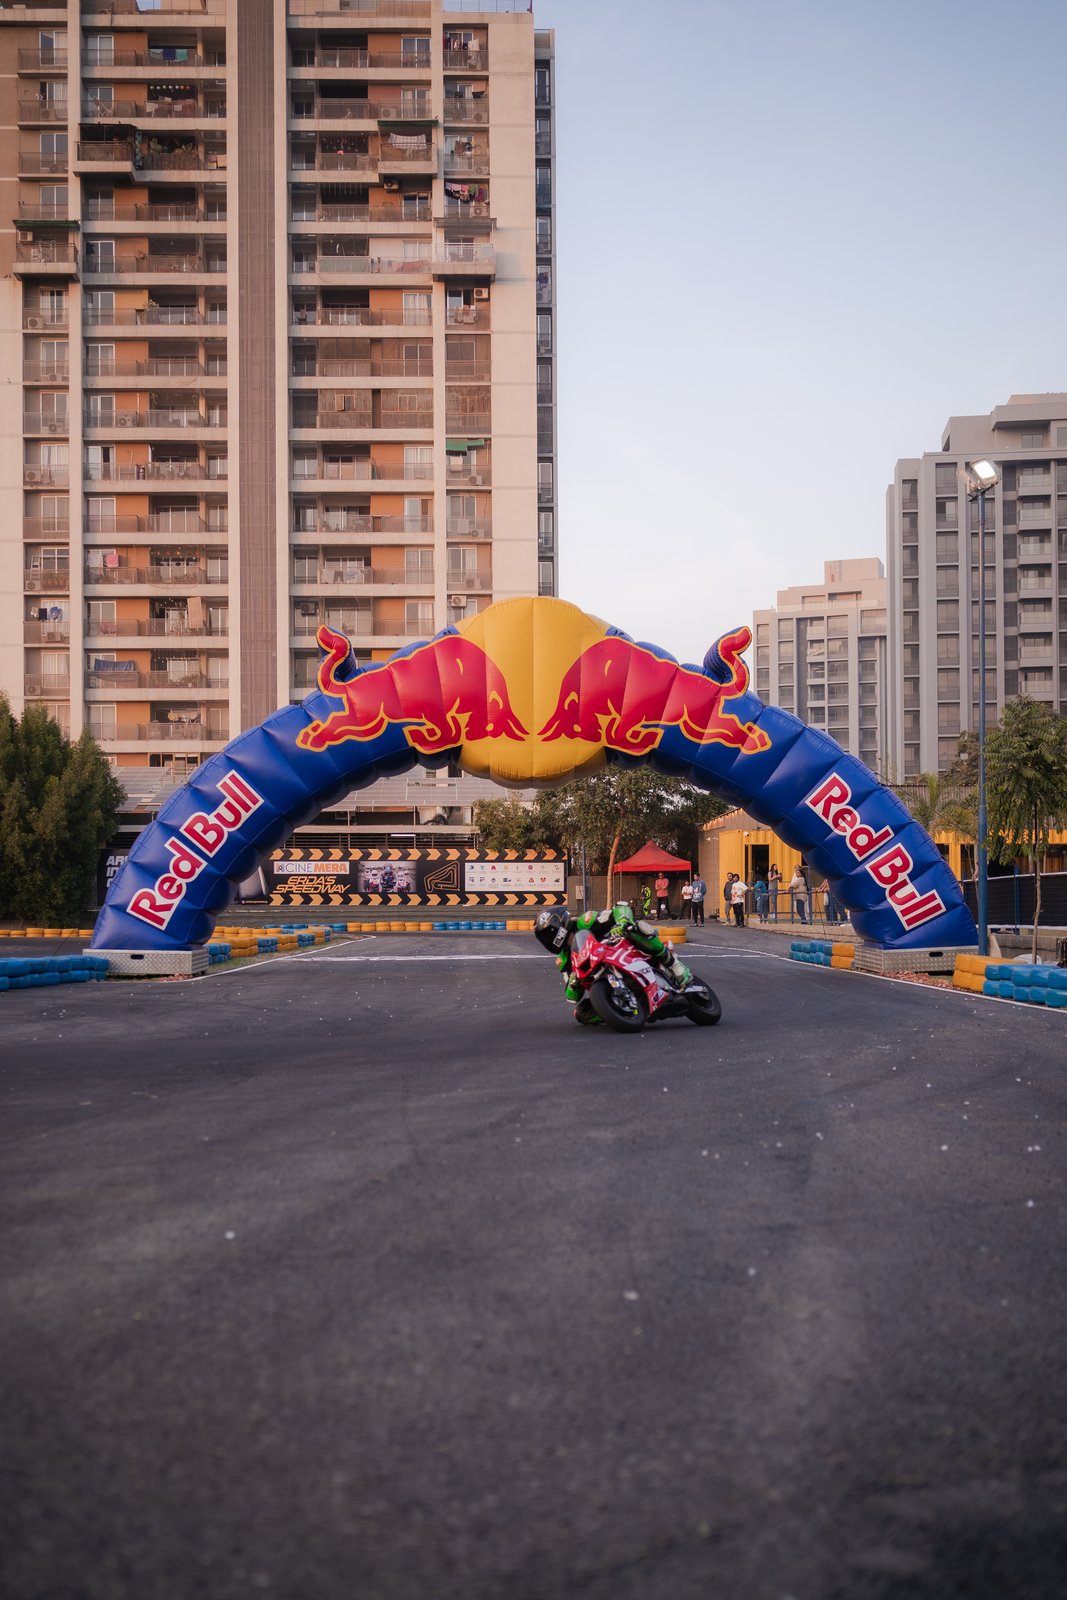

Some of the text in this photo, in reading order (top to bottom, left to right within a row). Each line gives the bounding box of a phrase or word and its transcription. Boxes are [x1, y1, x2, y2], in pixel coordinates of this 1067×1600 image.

[127, 769, 264, 930] Red Bull
[272, 884, 350, 893] SPEEDWAY
[287, 875, 337, 885] ERDA'S
[805, 772, 946, 931] Red Bull
